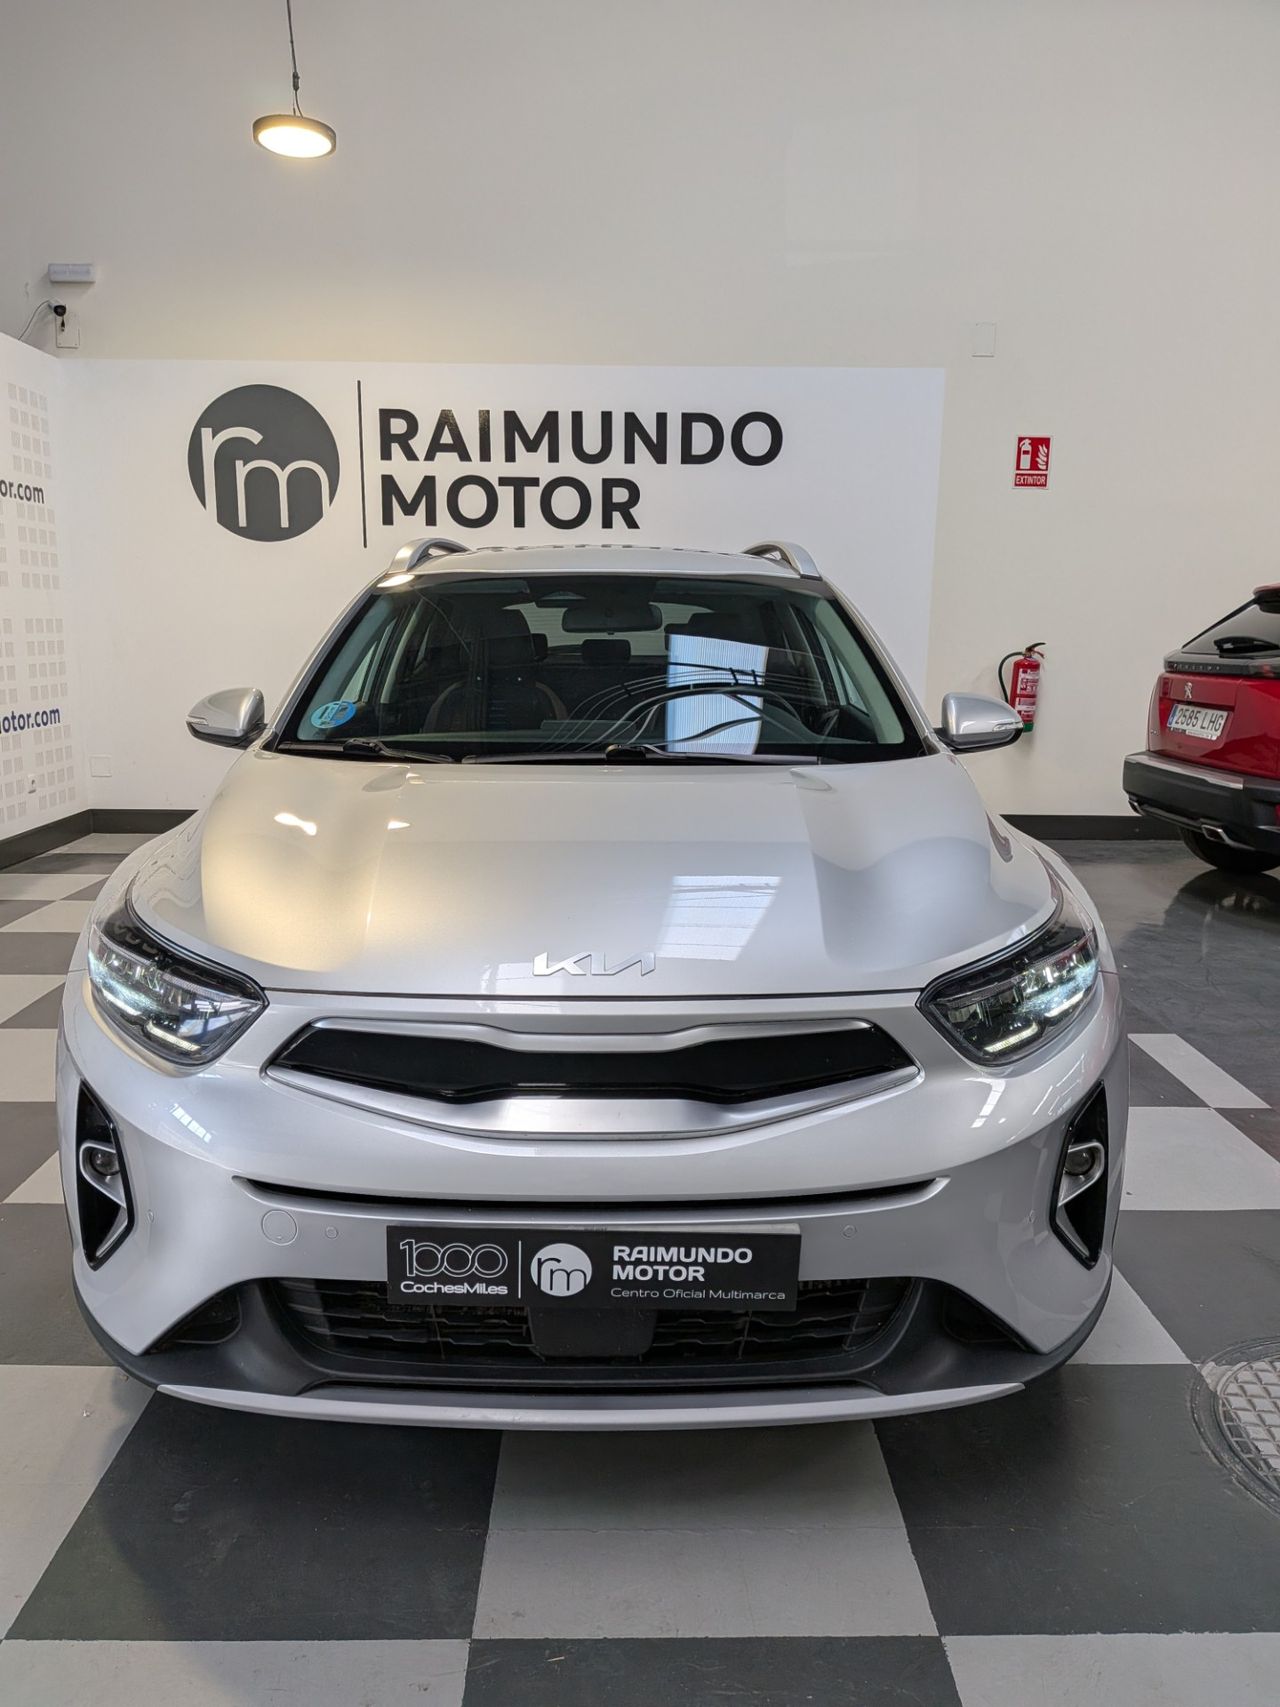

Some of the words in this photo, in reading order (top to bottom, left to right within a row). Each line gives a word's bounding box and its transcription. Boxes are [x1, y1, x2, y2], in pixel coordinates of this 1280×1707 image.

[379, 408, 783, 466] RAIMUNDO
[1016, 475, 1046, 485] EXTINTOR
[381, 474, 641, 529] MOTOR
[0, 708, 61, 734] otor.com
[1175, 708, 1202, 727] 2585
[1200, 711, 1224, 732] LHG
[533, 951, 656, 977] KIA
[400, 1239, 509, 1278] 1000
[613, 1245, 753, 1264] RAIMUNDO
[612, 1265, 705, 1281] MOTOR
[610, 1287, 660, 1298] Centro
[663, 1288, 706, 1299] Oficial
[709, 1290, 786, 1300] Multimarca
